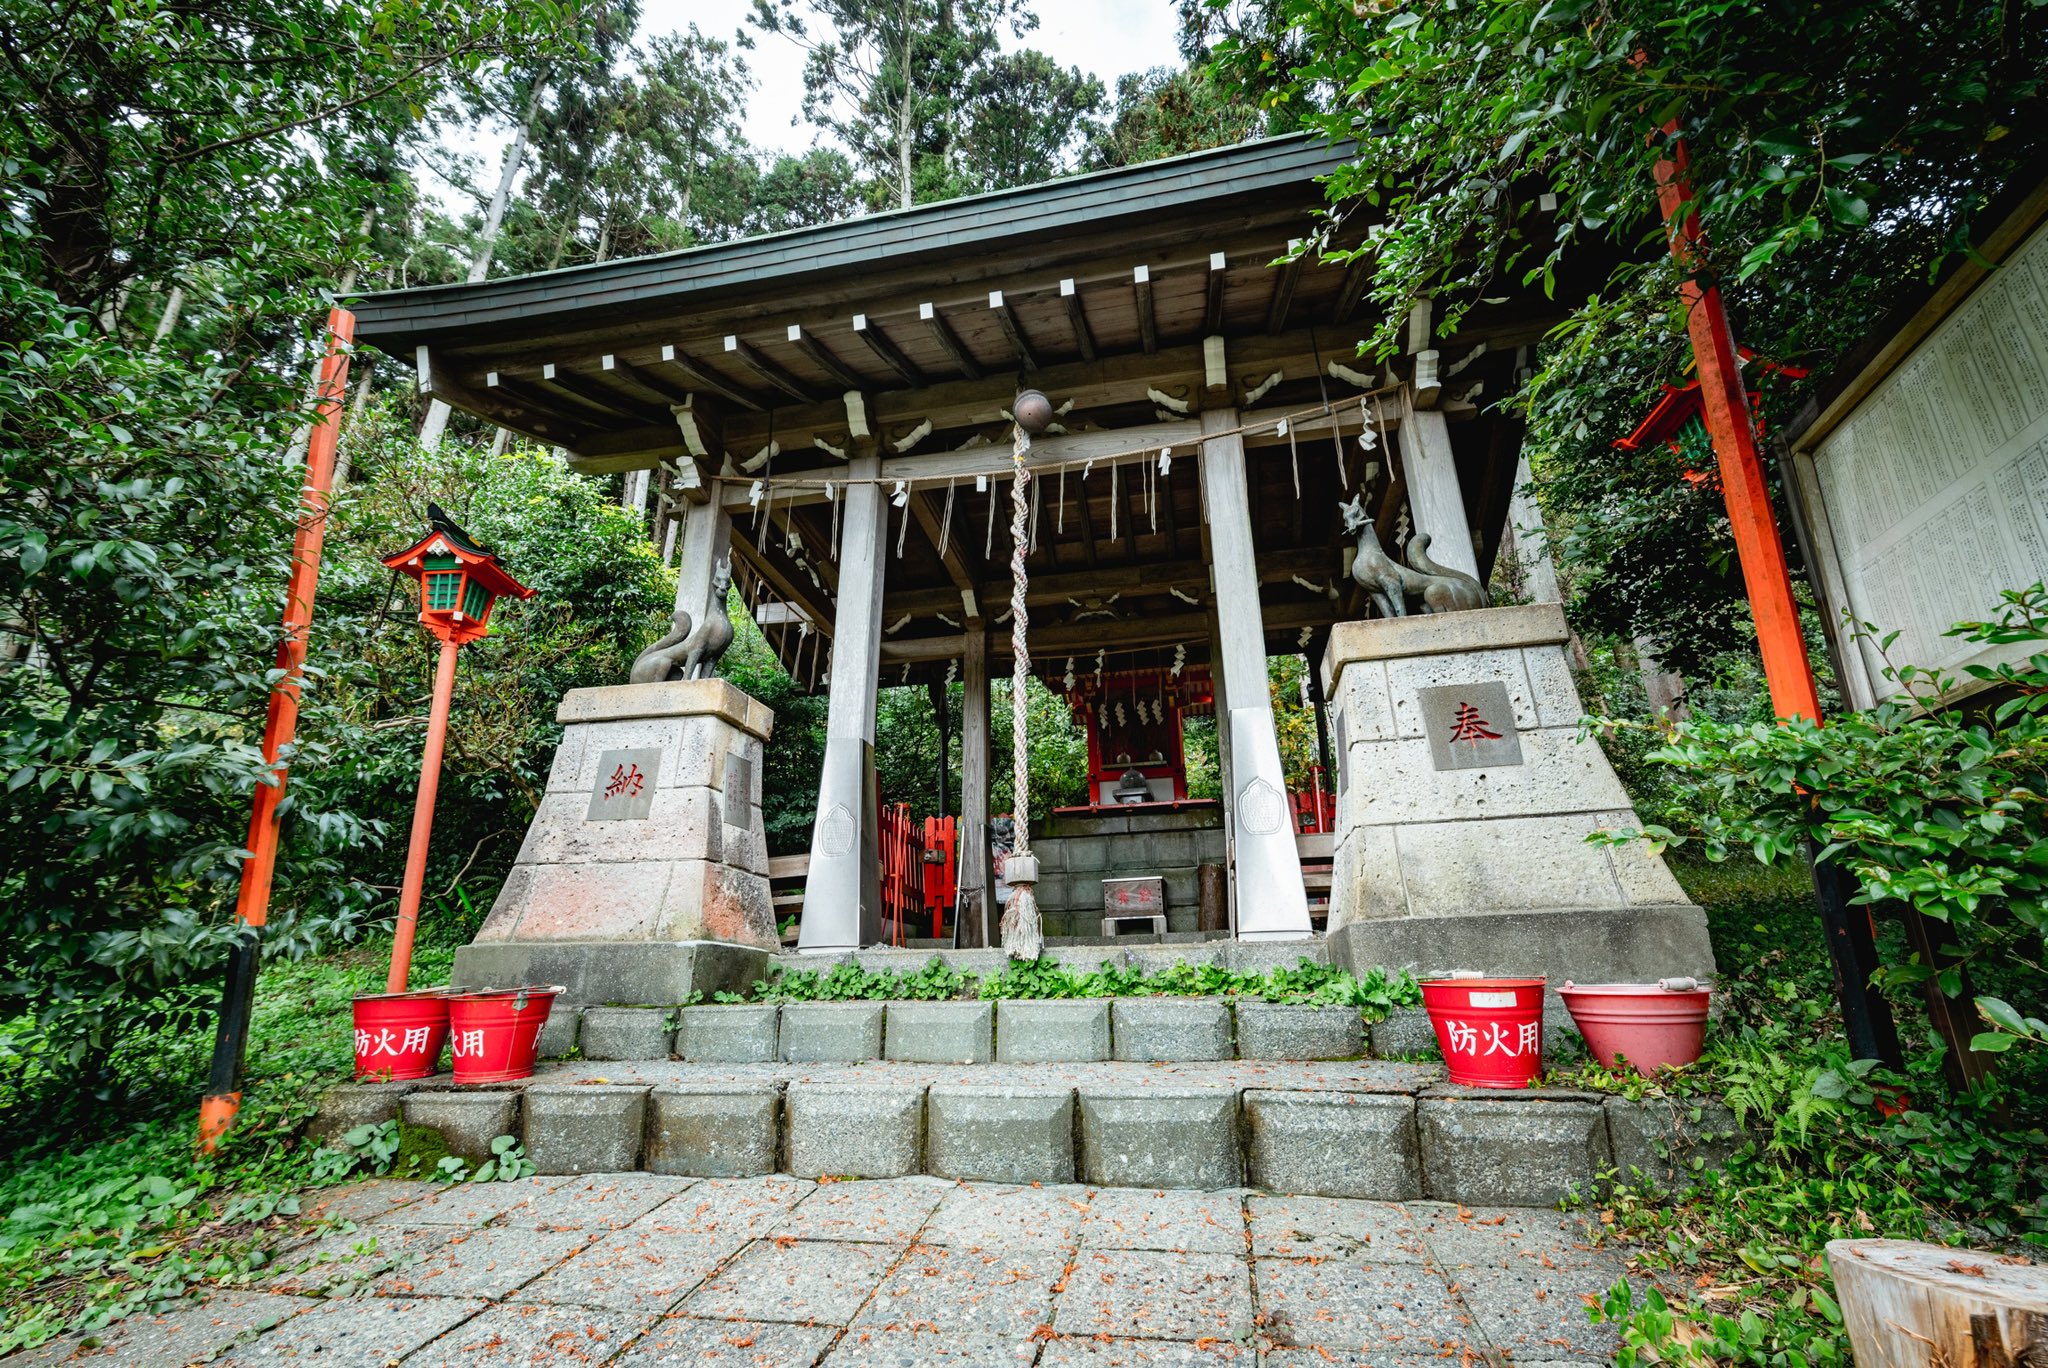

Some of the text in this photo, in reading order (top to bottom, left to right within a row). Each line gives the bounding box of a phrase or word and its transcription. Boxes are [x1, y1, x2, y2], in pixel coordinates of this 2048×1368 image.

[1450, 702, 1503, 748] 奉
[604, 763, 644, 801] 納
[354, 1025, 431, 1058] 防火用
[1445, 1019, 1540, 1057] 防火用
